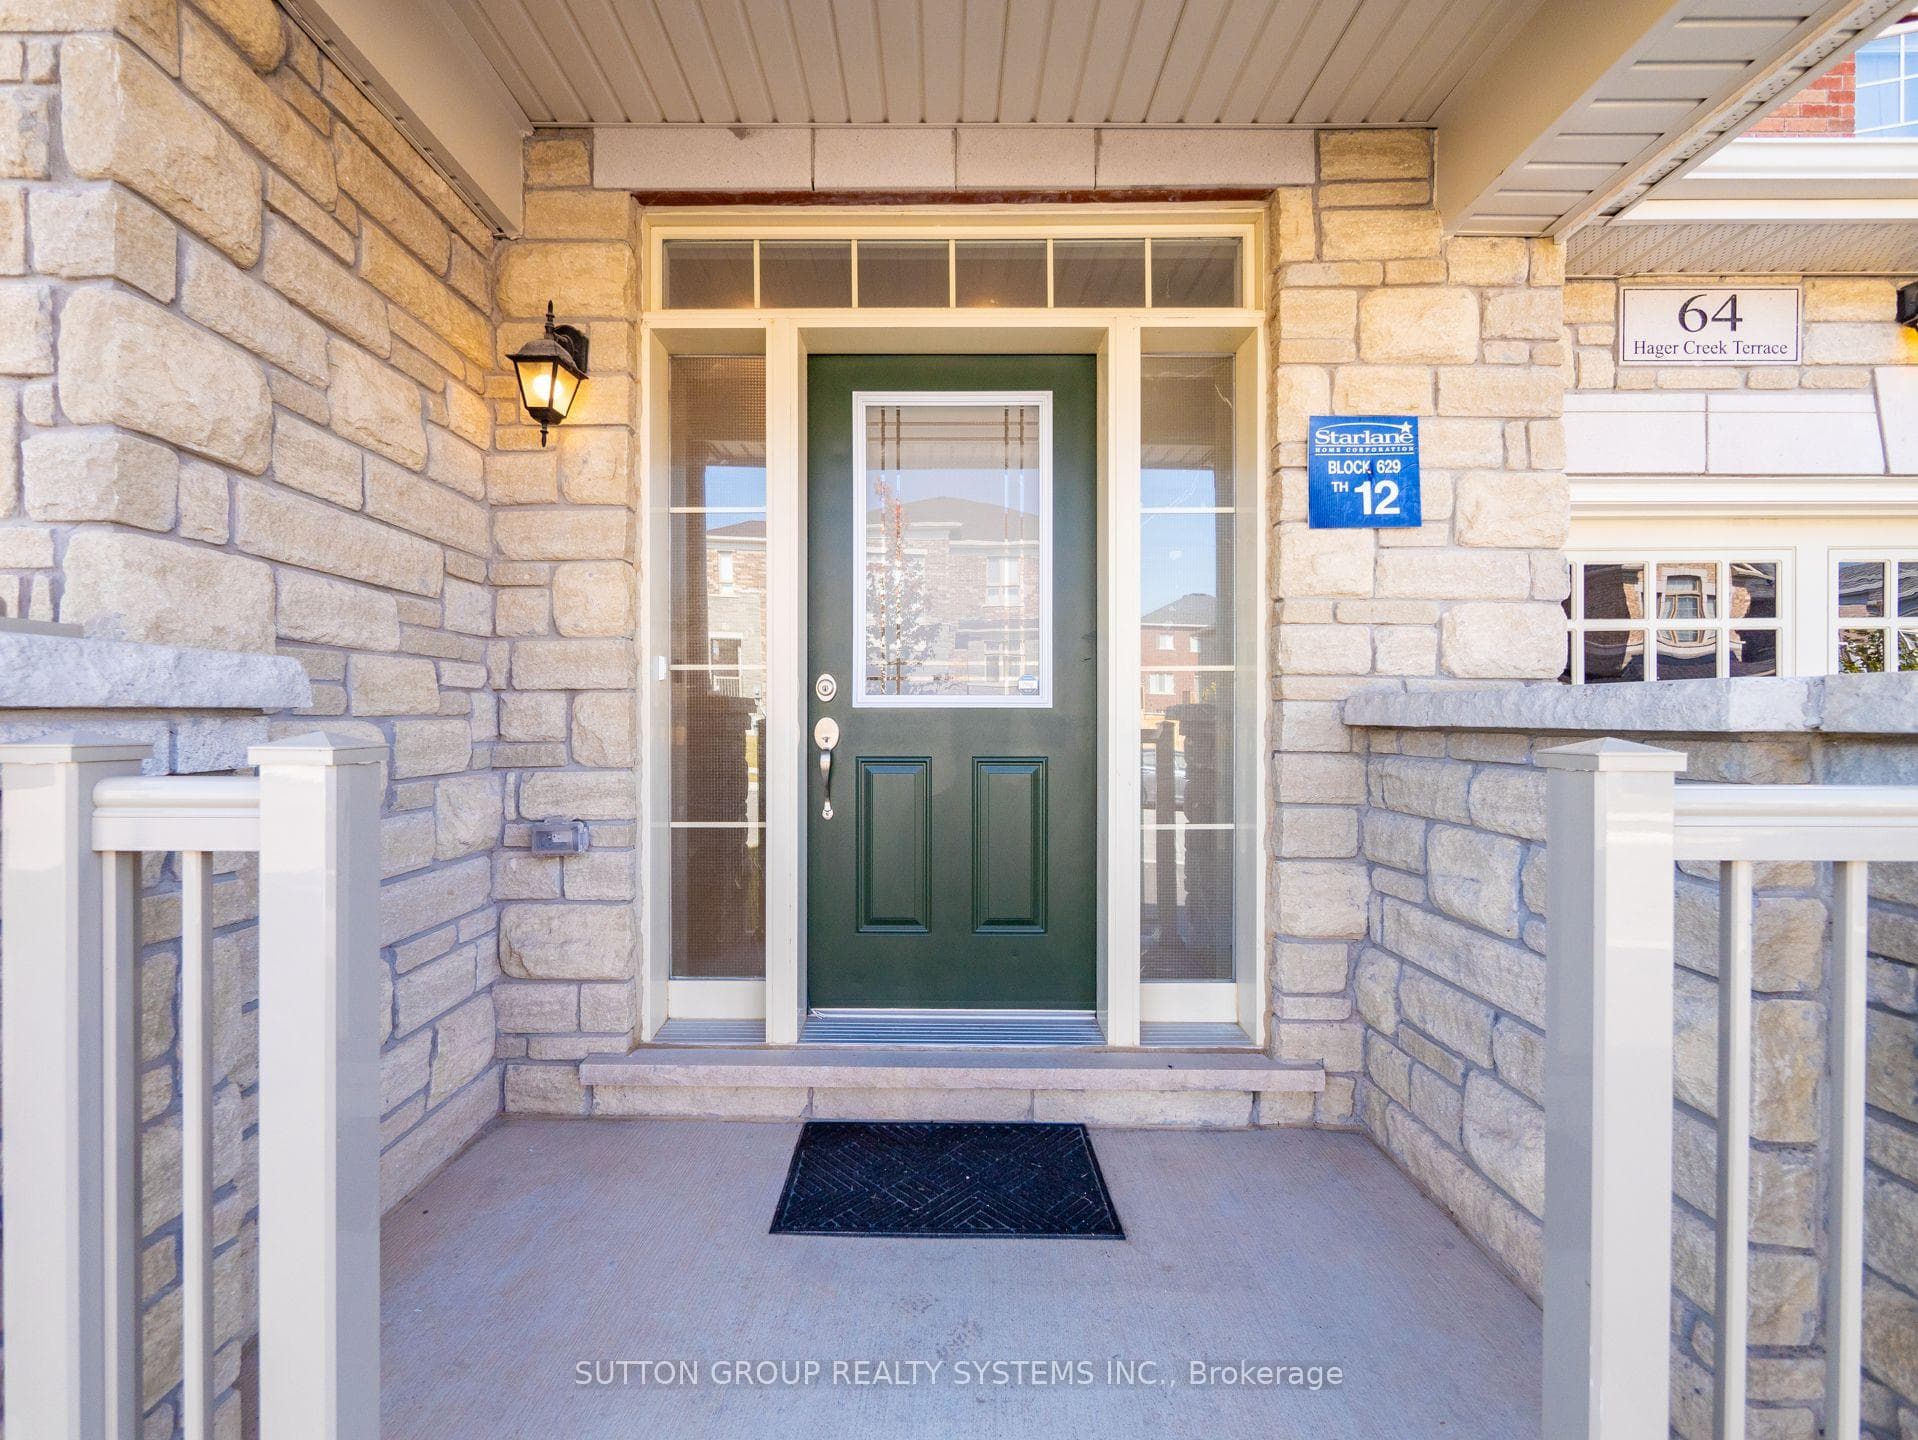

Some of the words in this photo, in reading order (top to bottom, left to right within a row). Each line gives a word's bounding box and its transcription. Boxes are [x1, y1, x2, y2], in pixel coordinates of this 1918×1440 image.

[1678, 293, 1743, 333] 64
[1634, 340, 1679, 358] Hager
[1683, 340, 1727, 355] Creek
[1732, 340, 1788, 355] Terrace
[1314, 428, 1414, 445] Starlane
[1328, 460, 1372, 475] BLOCK
[1376, 459, 1402, 474] 629
[1331, 481, 1349, 493] TH
[1354, 479, 1401, 516] 12
